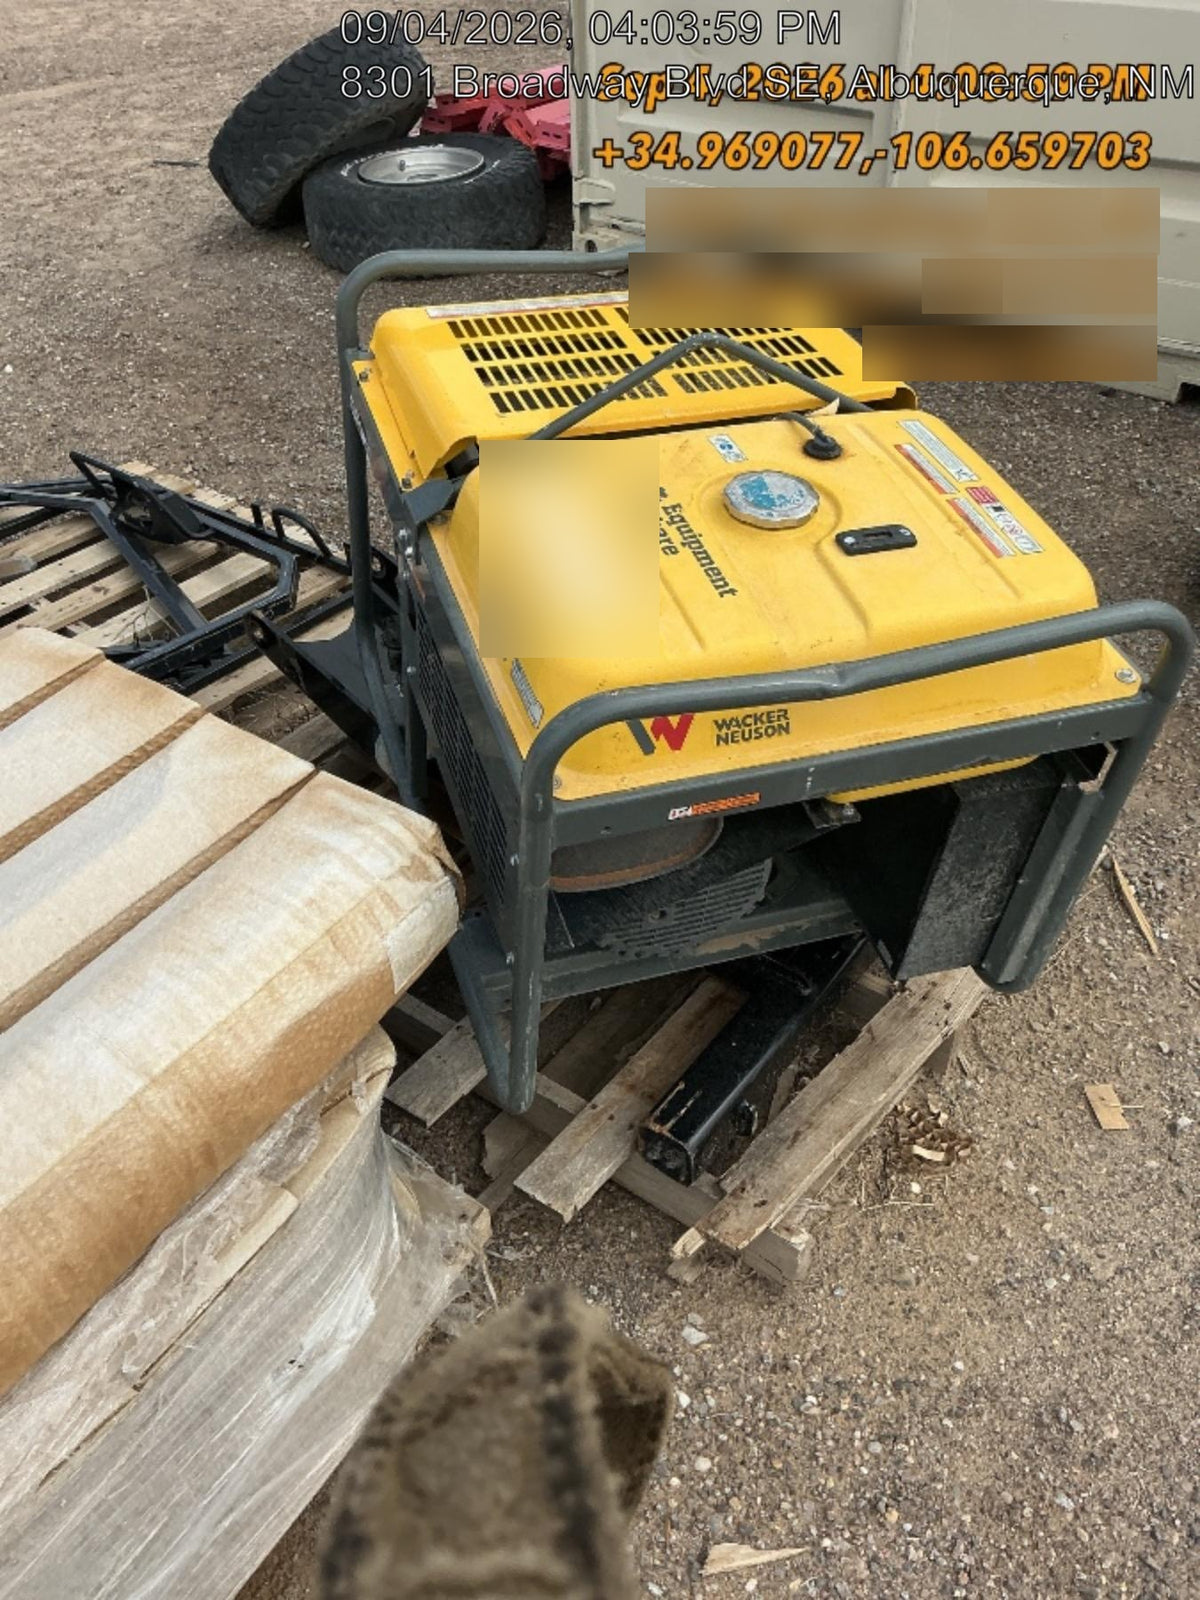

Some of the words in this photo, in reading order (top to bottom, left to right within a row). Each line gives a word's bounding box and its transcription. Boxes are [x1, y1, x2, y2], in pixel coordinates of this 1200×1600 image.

[662, 502, 738, 598] Equipment
[713, 708, 790, 733] WACKER
[716, 722, 790, 747] NEUSON
